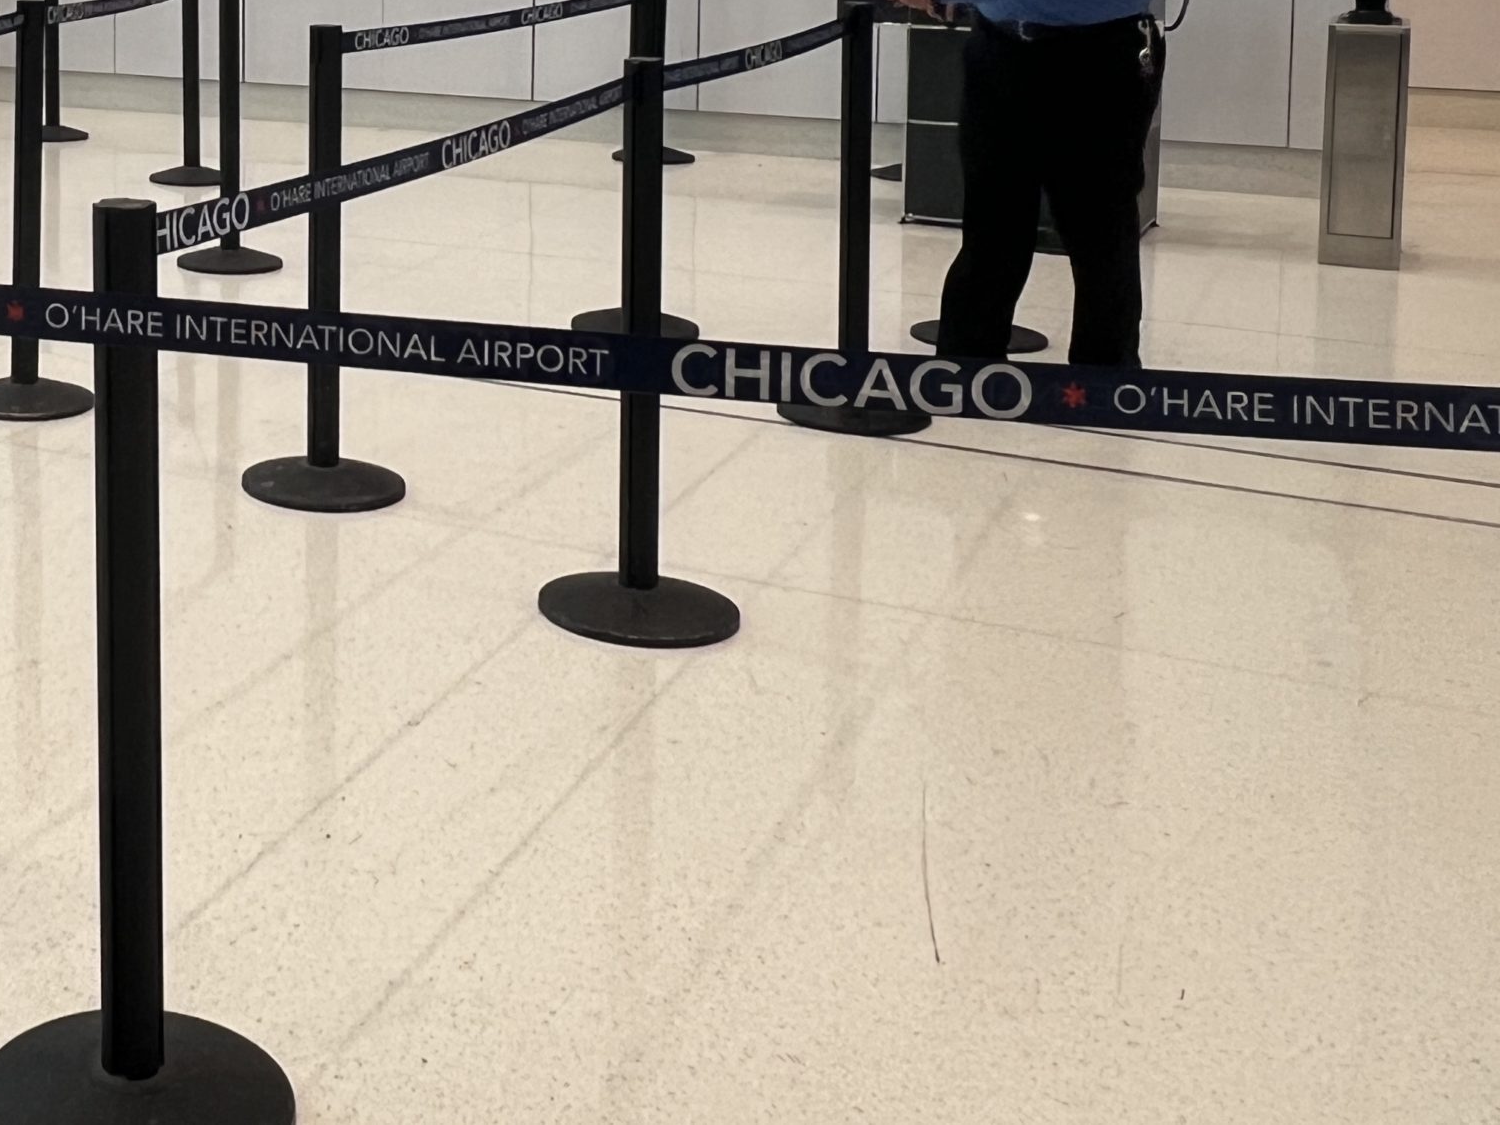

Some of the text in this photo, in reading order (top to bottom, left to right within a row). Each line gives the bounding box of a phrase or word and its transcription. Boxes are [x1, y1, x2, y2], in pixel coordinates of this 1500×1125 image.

[355, 26, 409, 51] CHICAGO
[156, 193, 250, 252] HICAGO
[270, 183, 312, 211] O'HARE
[314, 166, 391, 200] INTERNATIONAL
[441, 120, 510, 169] CHICAGO
[45, 303, 163, 338] O'HARE
[175, 313, 445, 362] INTERNATIONAL
[456, 337, 609, 377] AIRPORT
[671, 343, 1033, 419] CHICAGO
[1113, 383, 1276, 423] O'HARE
[1293, 394, 1500, 435] INTERNAT
